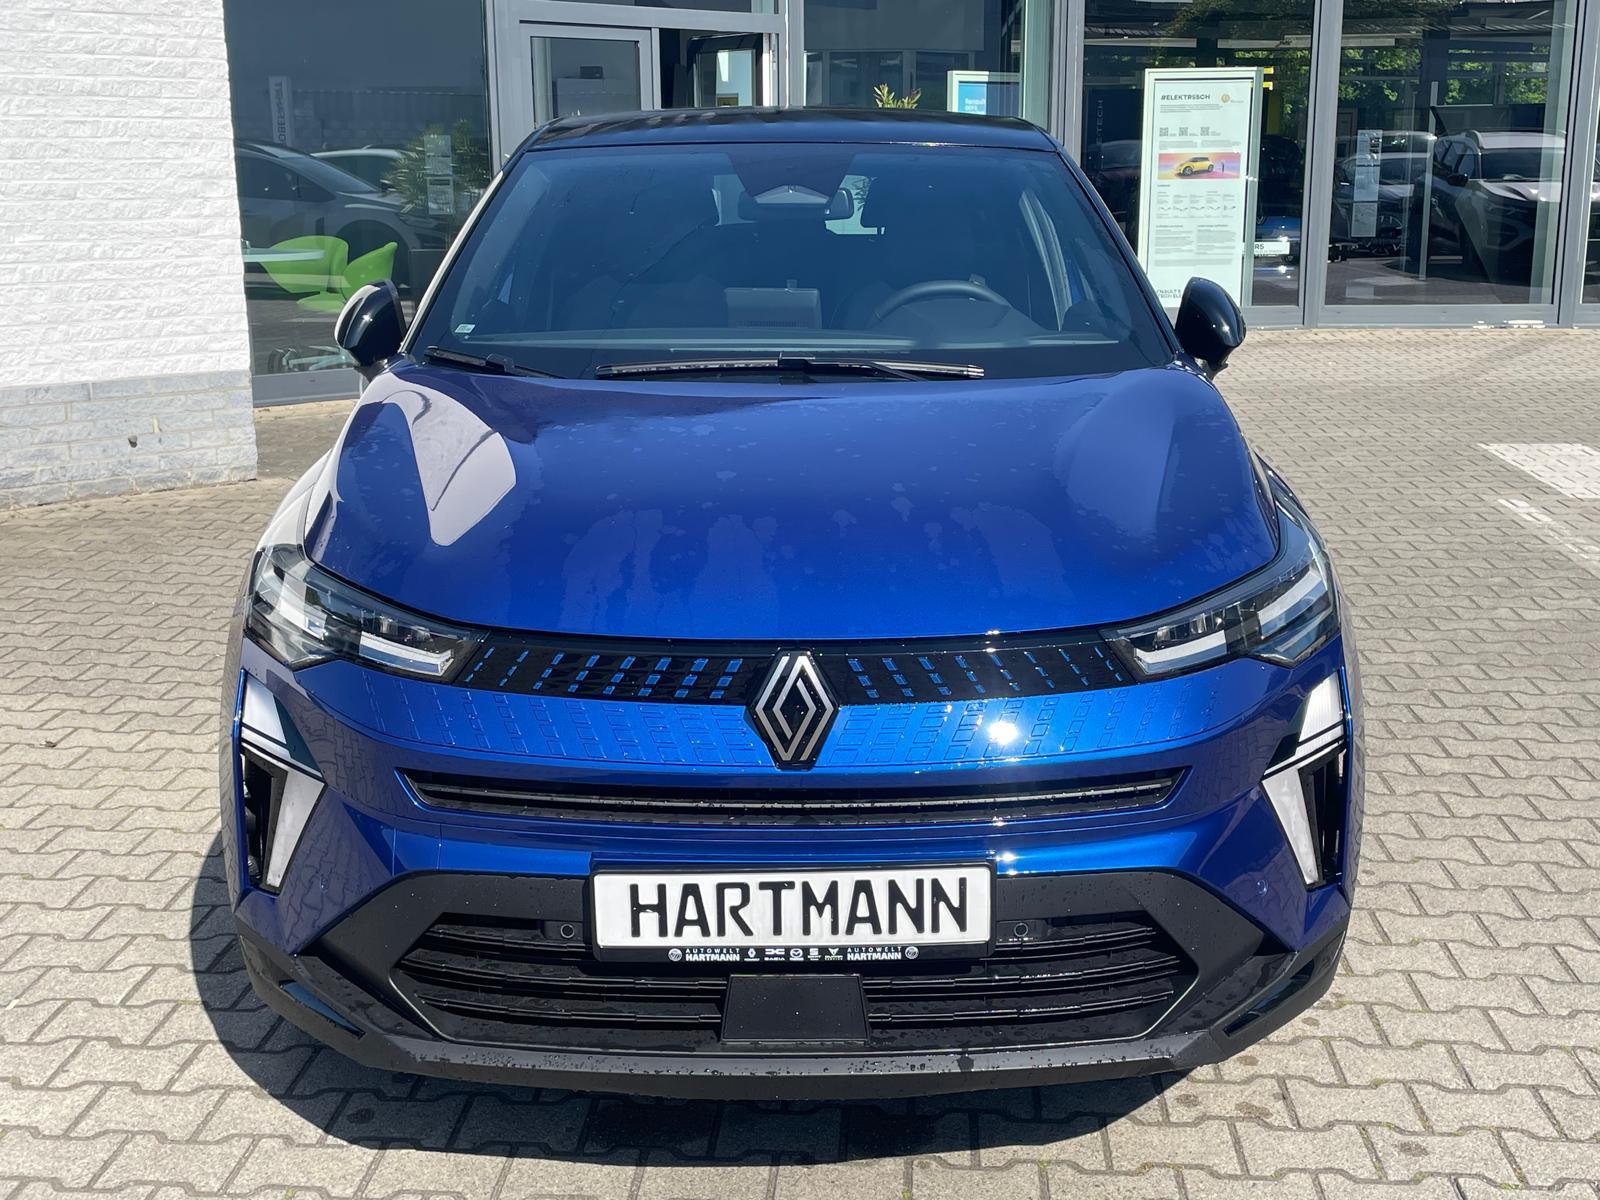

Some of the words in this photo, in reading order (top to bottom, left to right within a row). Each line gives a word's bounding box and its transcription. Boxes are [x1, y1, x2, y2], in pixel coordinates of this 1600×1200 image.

[629, 876, 967, 938] HARTMANN
[685, 953, 741, 962] HARTMANN
[847, 952, 902, 961] HARTMANN
